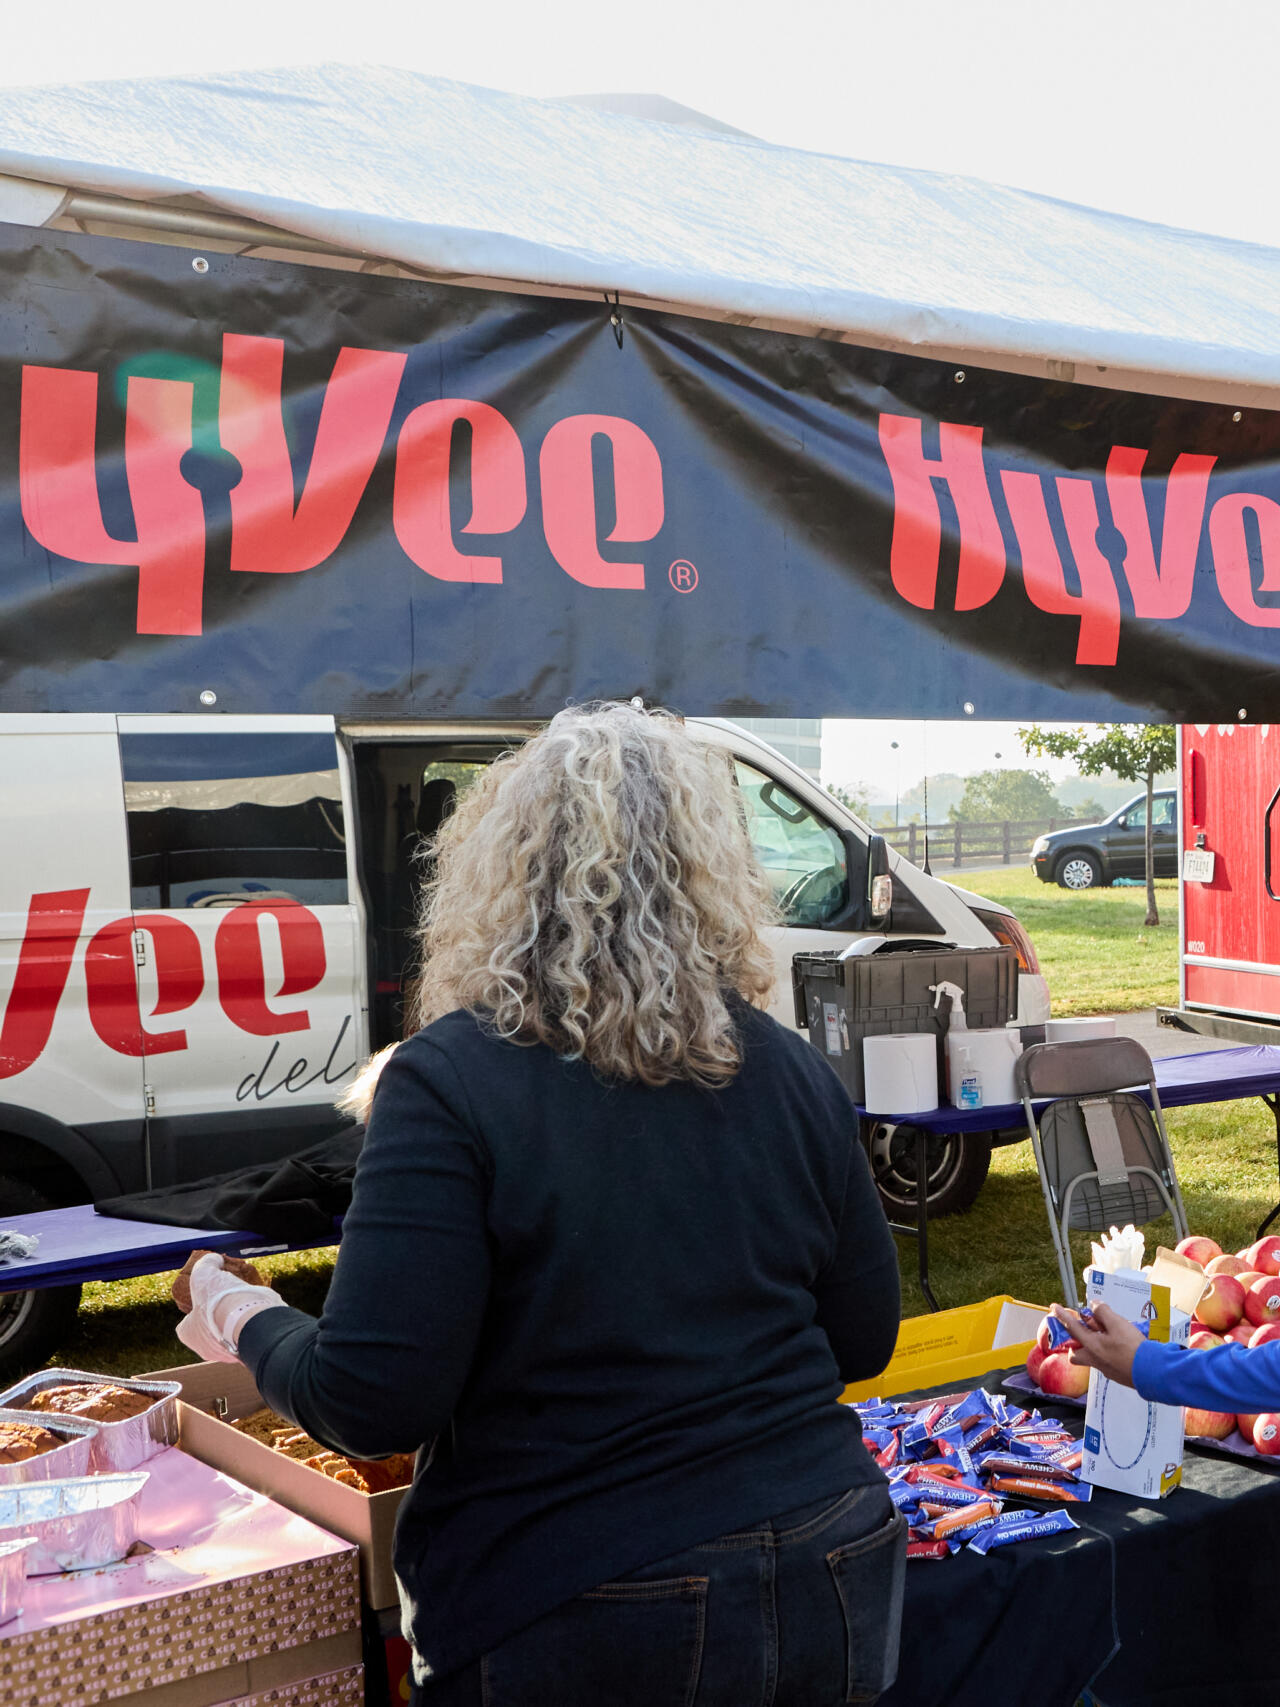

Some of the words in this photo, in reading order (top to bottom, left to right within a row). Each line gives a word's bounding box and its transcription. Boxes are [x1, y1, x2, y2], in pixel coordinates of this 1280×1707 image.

[1025, 1463, 1055, 1473] CHEWY
[946, 1492, 977, 1501] CHEWY
[1033, 1522, 1062, 1534] CHEWY
